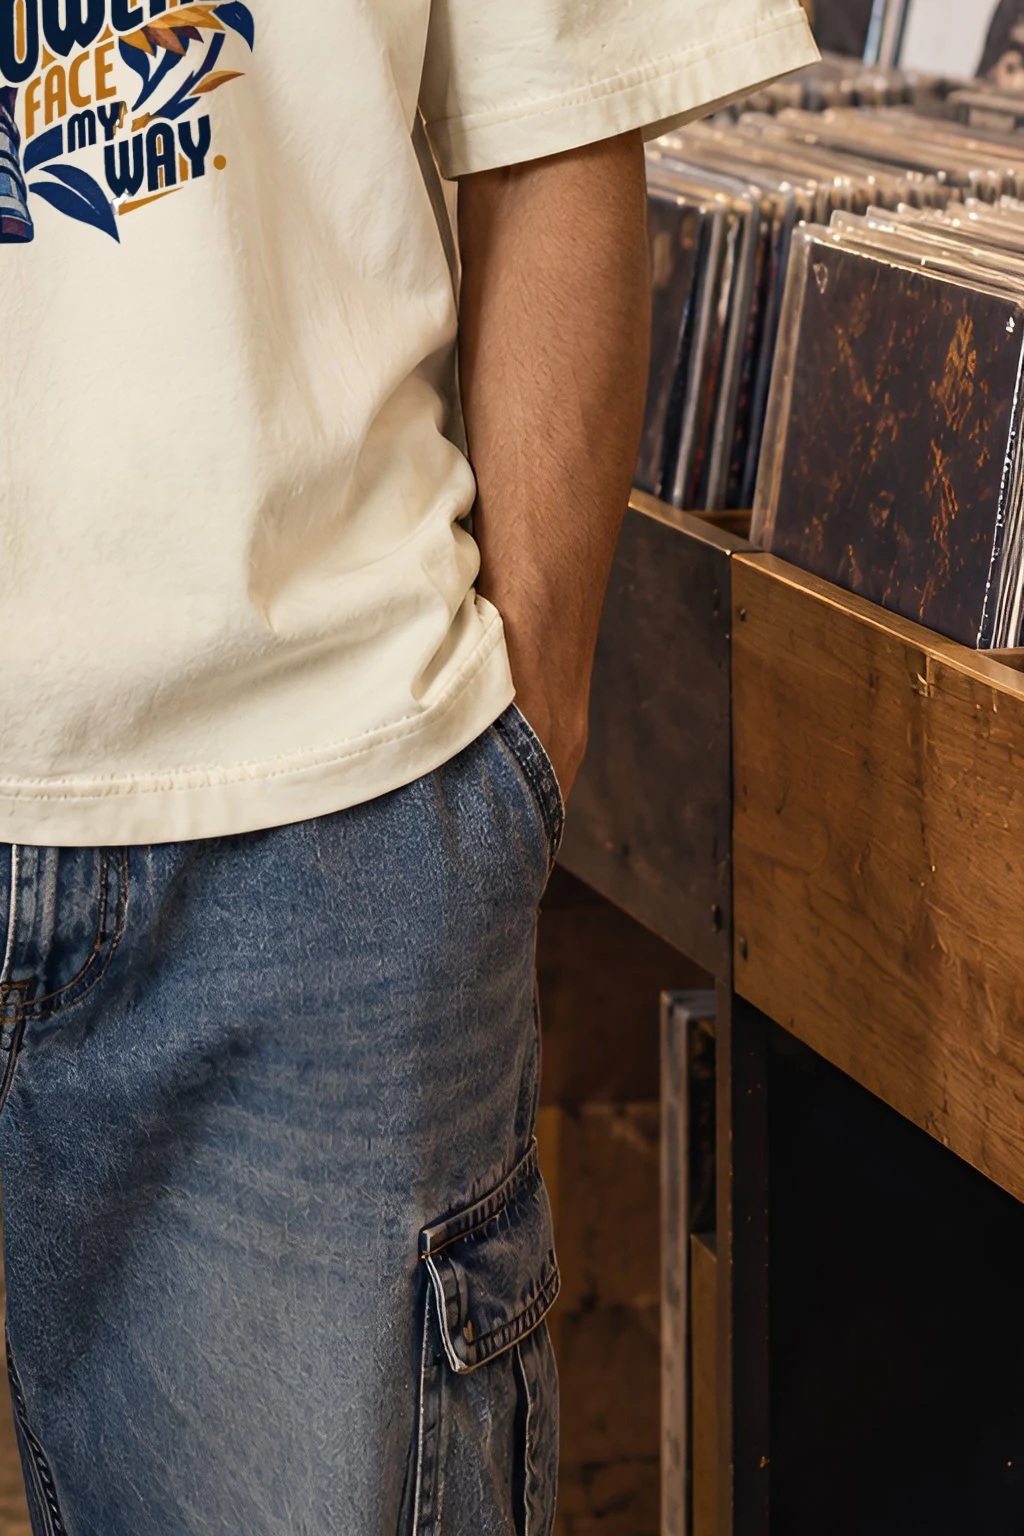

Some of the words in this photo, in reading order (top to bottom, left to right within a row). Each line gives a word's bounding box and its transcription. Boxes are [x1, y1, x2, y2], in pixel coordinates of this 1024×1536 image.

[25, 42, 117, 139] FACE
[66, 101, 122, 152] MY
[103, 115, 227, 198] WAY.
